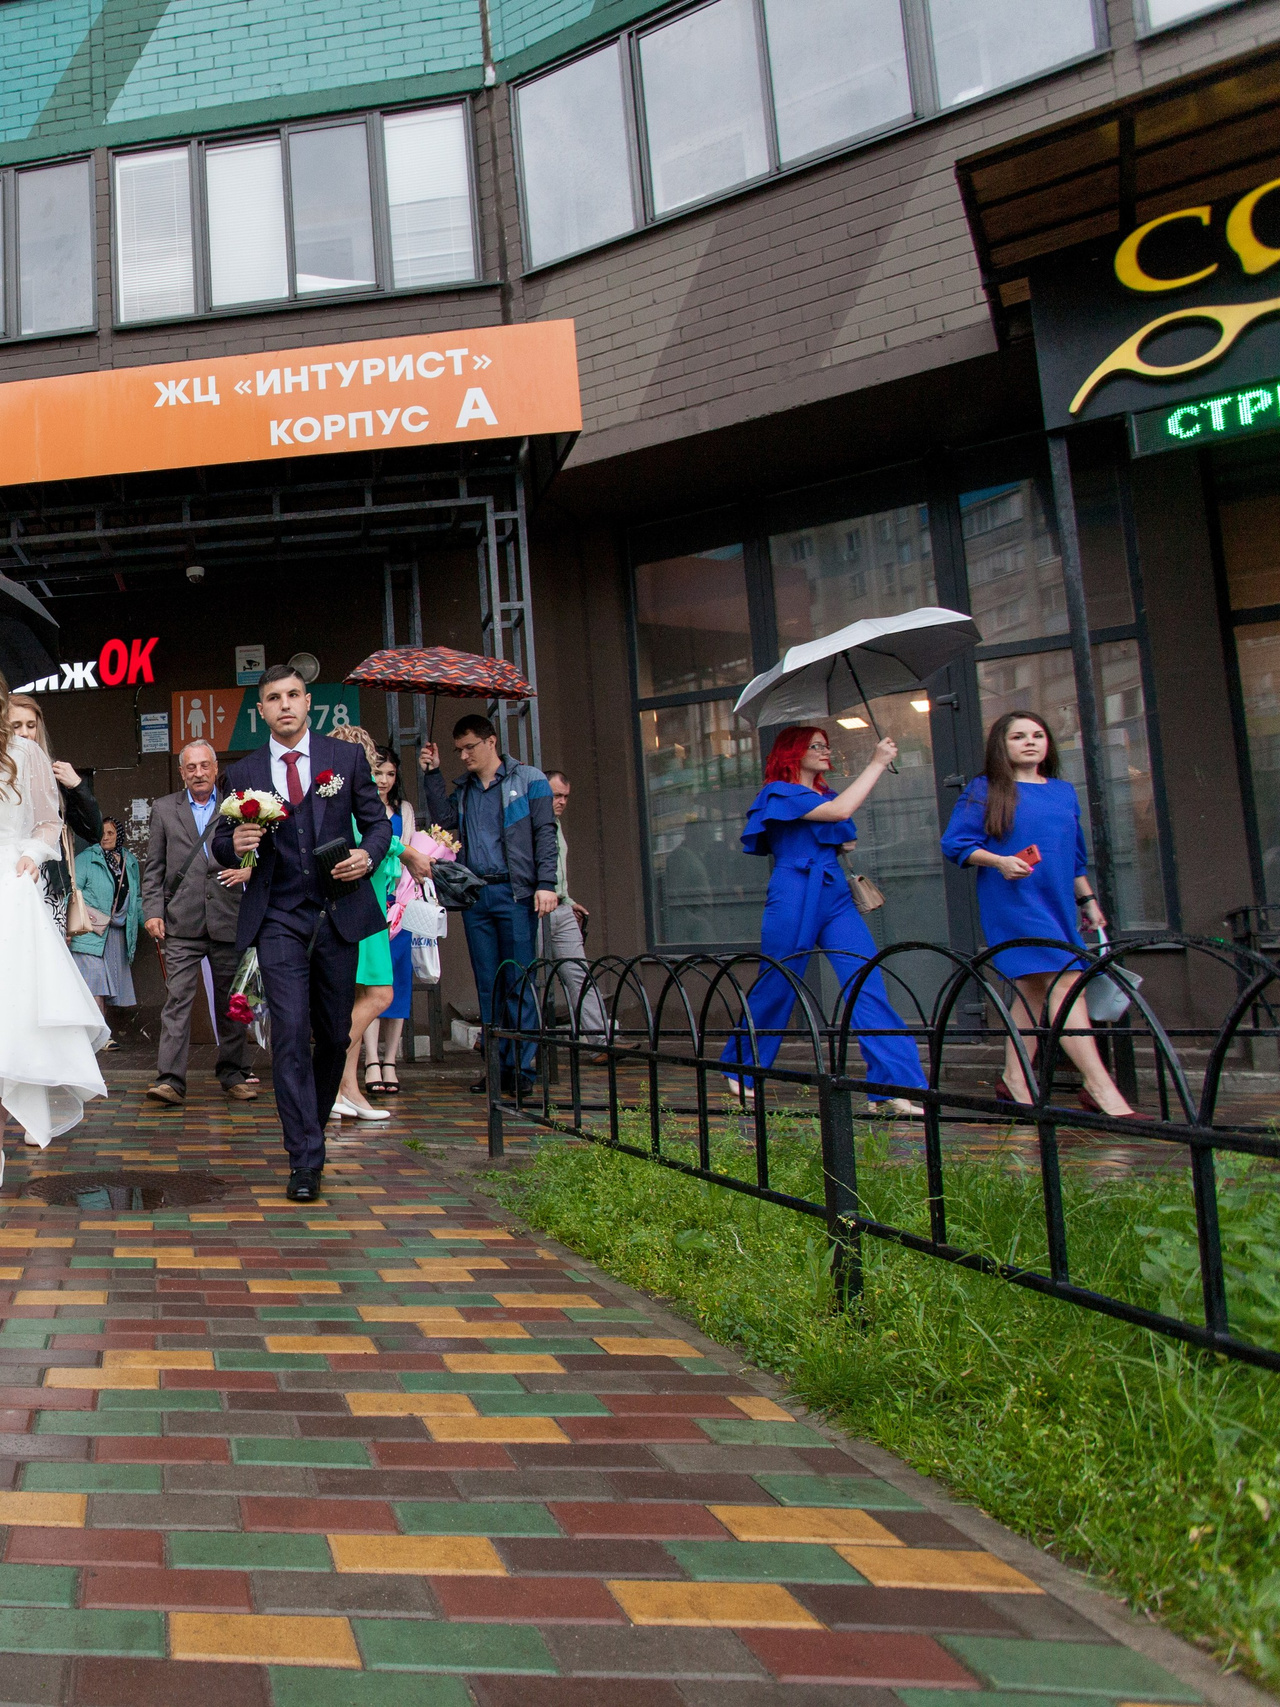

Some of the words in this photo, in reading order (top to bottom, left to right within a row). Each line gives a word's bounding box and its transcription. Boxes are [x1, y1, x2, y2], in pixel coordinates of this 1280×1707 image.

[154, 375, 220, 408] ЖЦ
[234, 348, 492, 396] «ИНТУРИСТ»
[270, 405, 429, 446] КОРПУС
[456, 387, 499, 428] А
[1167, 385, 1280, 440] СТР
